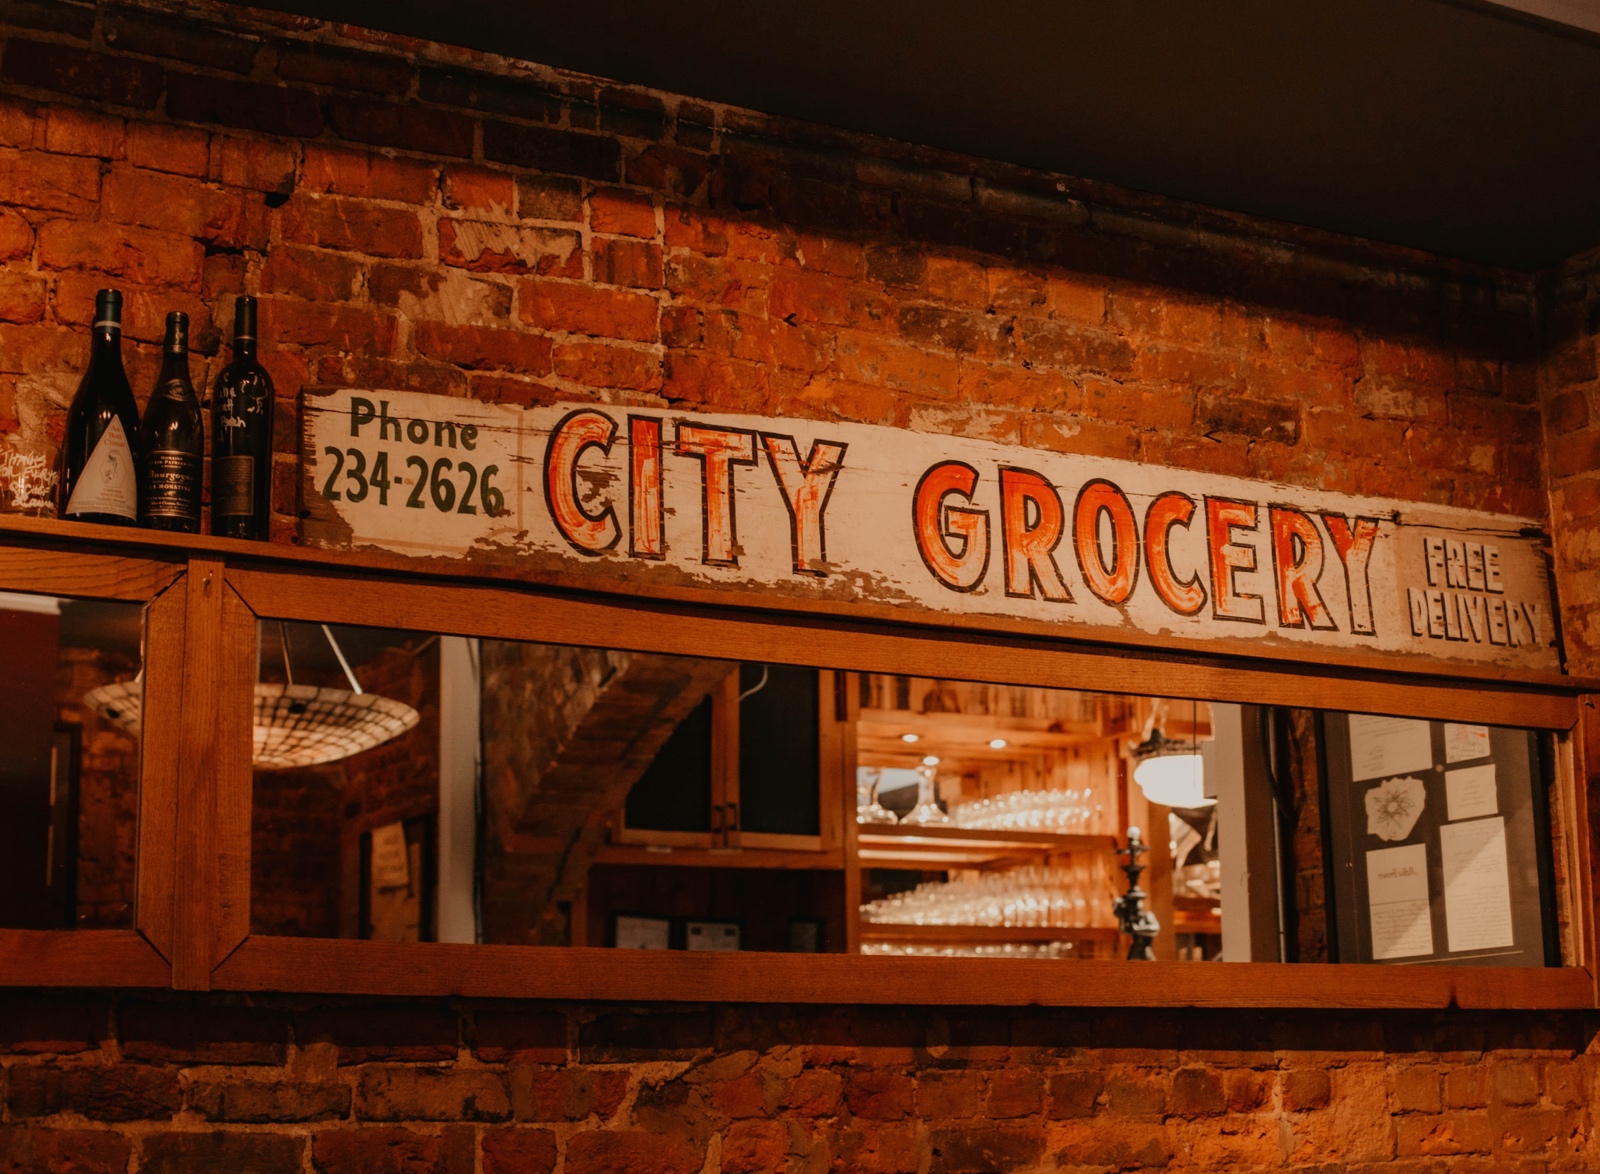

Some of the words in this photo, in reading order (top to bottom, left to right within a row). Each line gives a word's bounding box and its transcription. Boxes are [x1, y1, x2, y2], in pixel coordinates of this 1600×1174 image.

[103, 439, 125, 448] Climat
[108, 432, 122, 440] Bon
[350, 397, 478, 451] Phone
[322, 446, 505, 518] 234-2626
[543, 408, 849, 577] CITY
[912, 459, 1380, 637] GROCERY
[1424, 537, 1504, 595] FREE
[1407, 587, 1544, 648] DELIVERY
